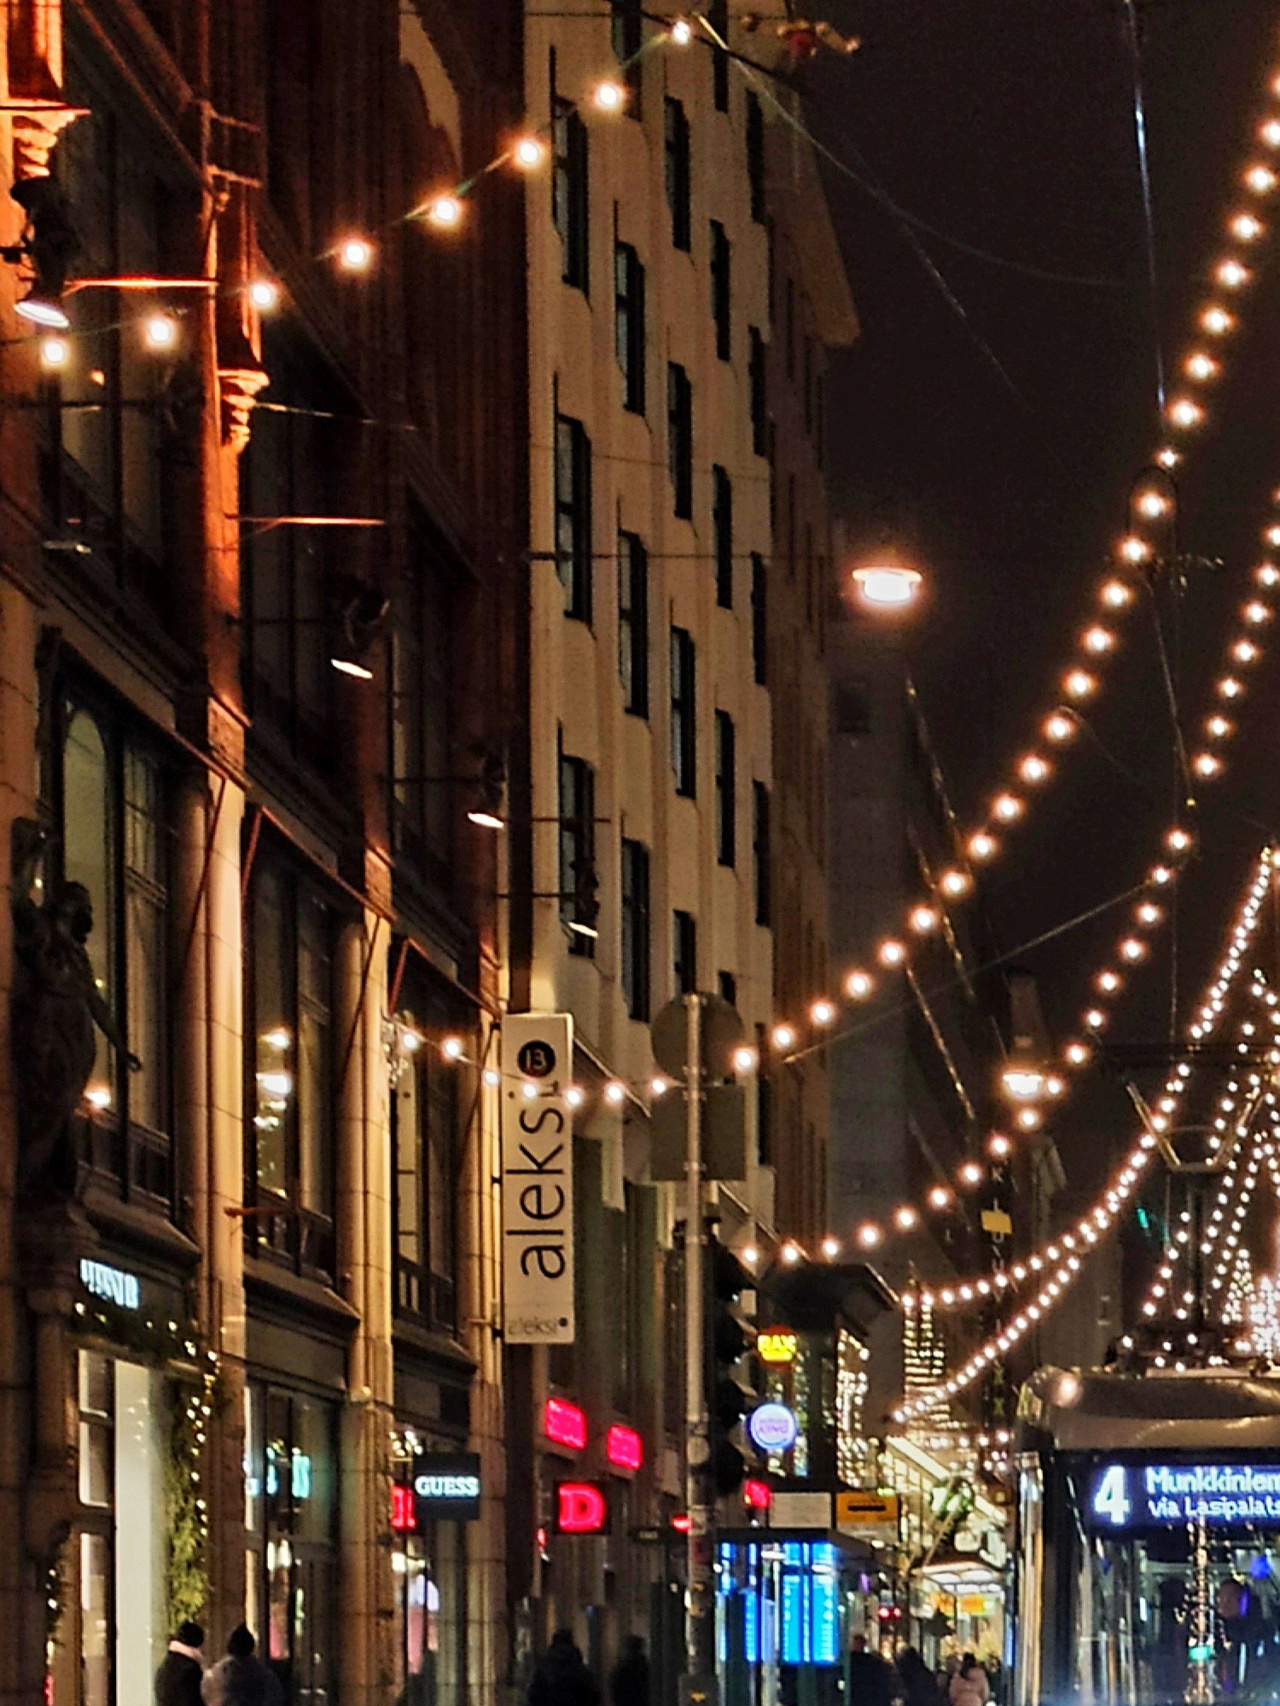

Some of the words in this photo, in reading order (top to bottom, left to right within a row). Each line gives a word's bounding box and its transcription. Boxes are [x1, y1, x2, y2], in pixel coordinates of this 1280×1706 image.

[504, 1088, 566, 1280] aleksi
[414, 1475, 480, 1497] GUESS
[1094, 1465, 1130, 1525] 4
[1148, 1496, 1180, 1517] via
